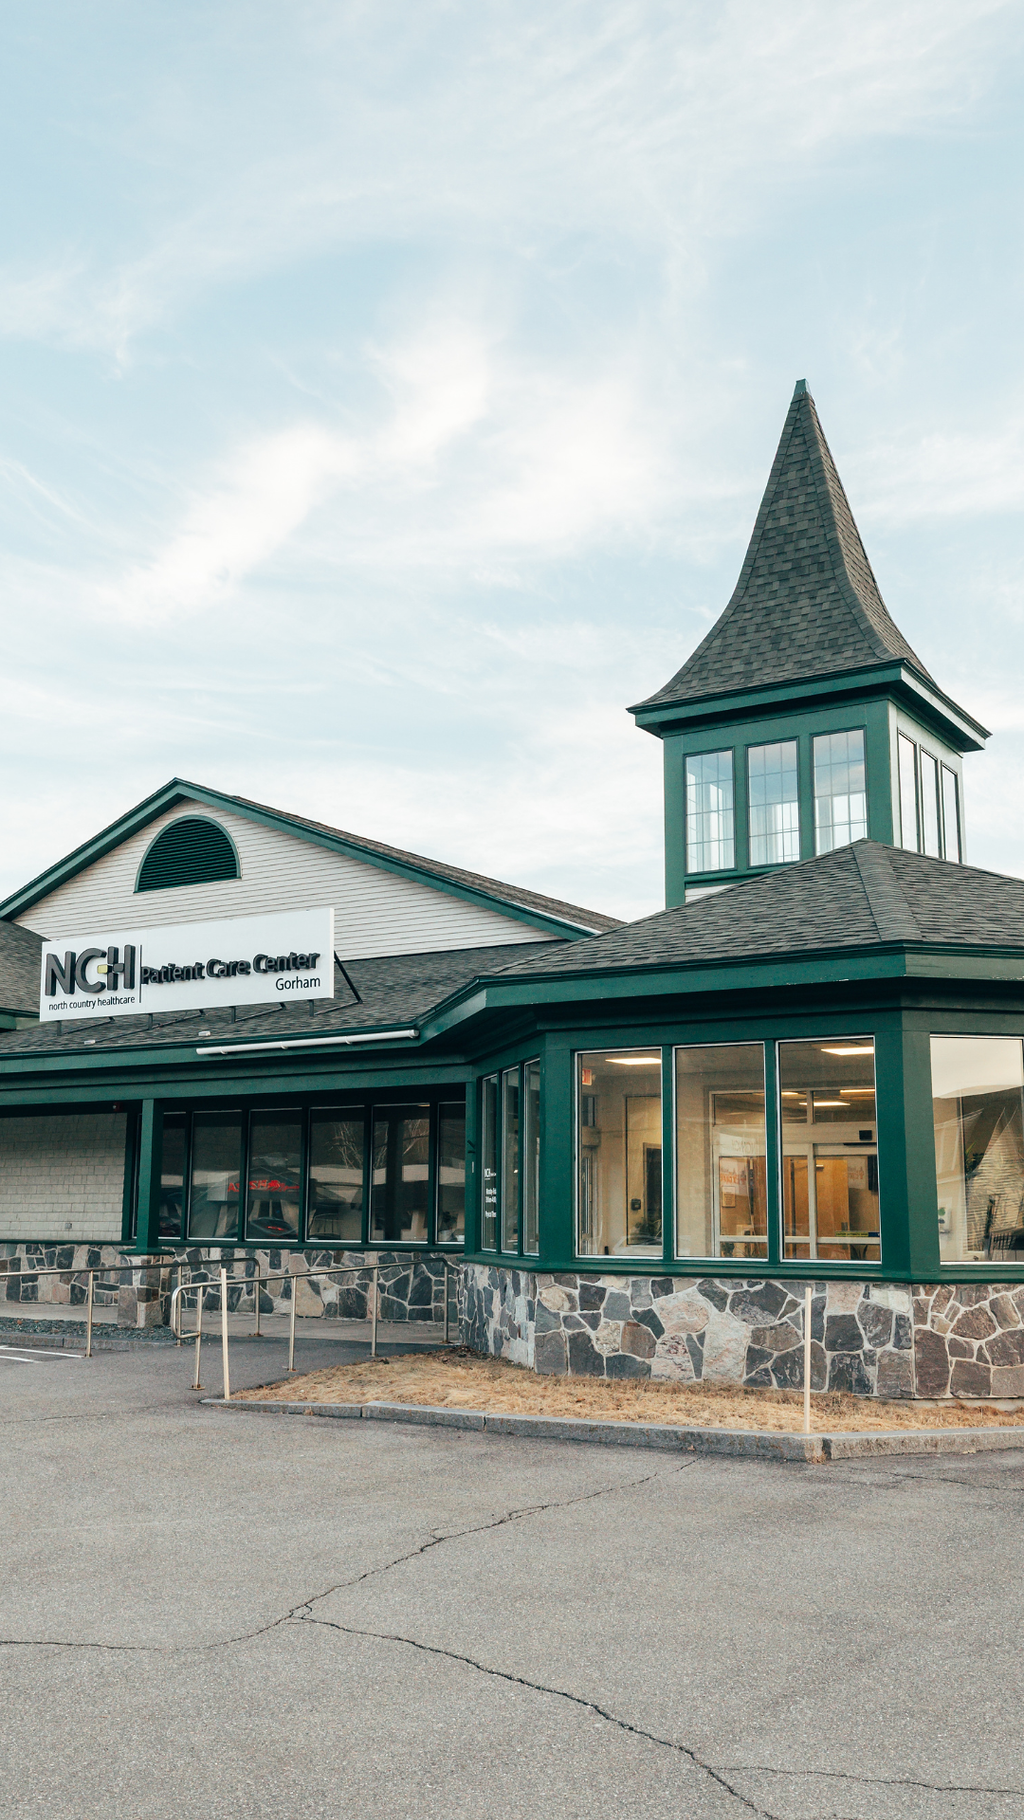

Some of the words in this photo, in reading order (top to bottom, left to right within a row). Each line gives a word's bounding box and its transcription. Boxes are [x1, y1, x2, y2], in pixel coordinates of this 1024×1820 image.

[45, 944, 136, 996] NCH
[141, 962, 205, 985] Patient
[206, 958, 251, 978] Care
[253, 952, 320, 974] Center
[275, 976, 321, 991] Gorham
[48, 1001, 68, 1011] north
[69, 999, 96, 1009] country
[97, 996, 136, 1006] healthcare
